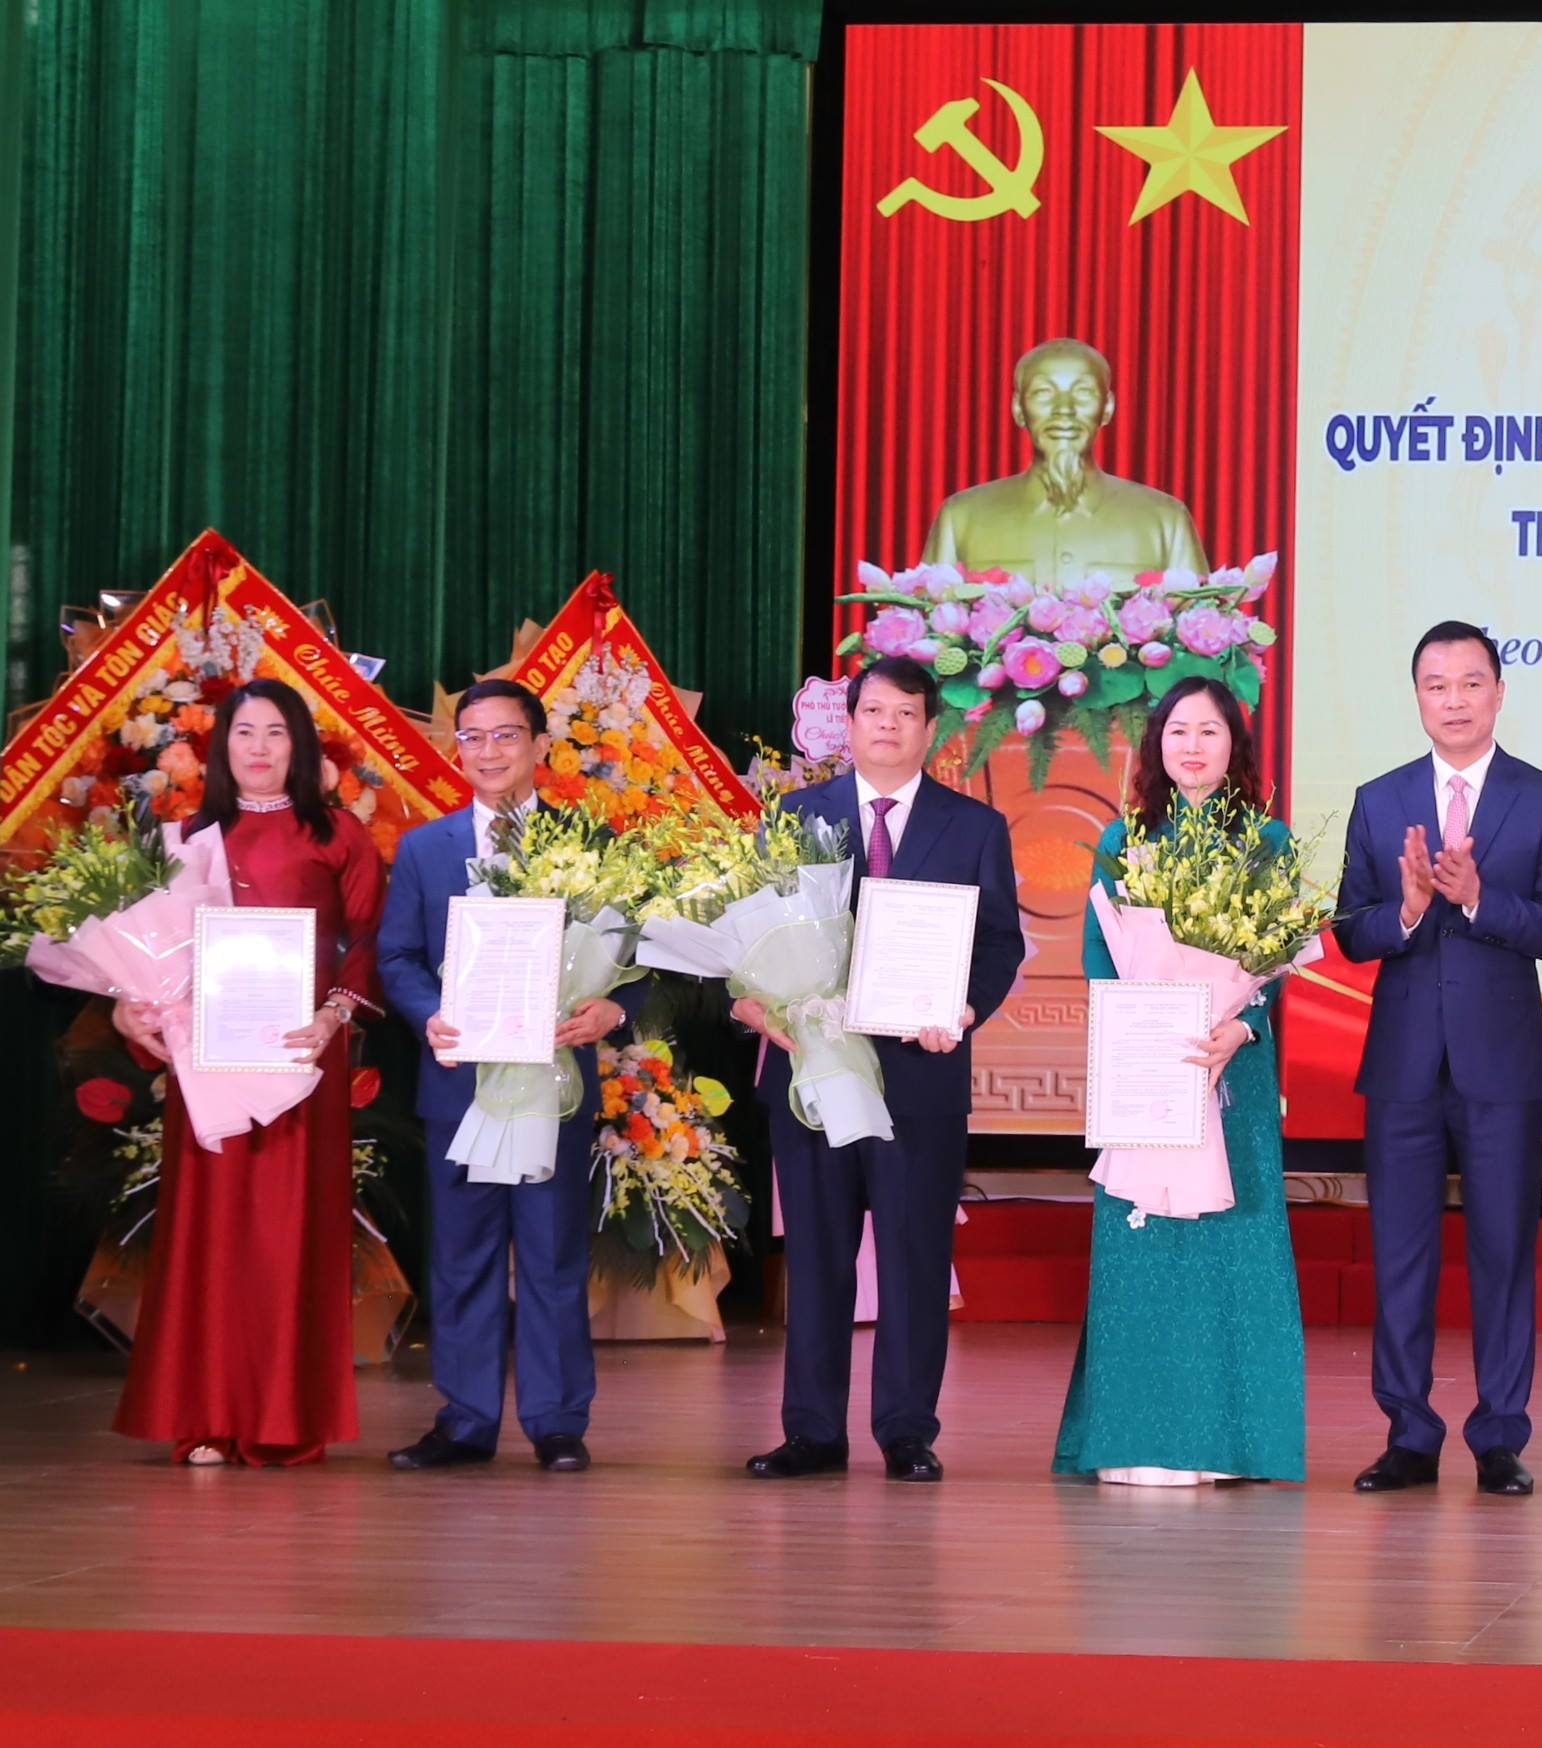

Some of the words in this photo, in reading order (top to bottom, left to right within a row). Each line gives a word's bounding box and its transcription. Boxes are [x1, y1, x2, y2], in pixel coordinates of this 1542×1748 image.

[1326, 396, 1456, 473] QUYẾT
[69, 683, 107, 718] VÀ
[96, 639, 145, 687] TÔN
[537, 631, 574, 672] TẠO
